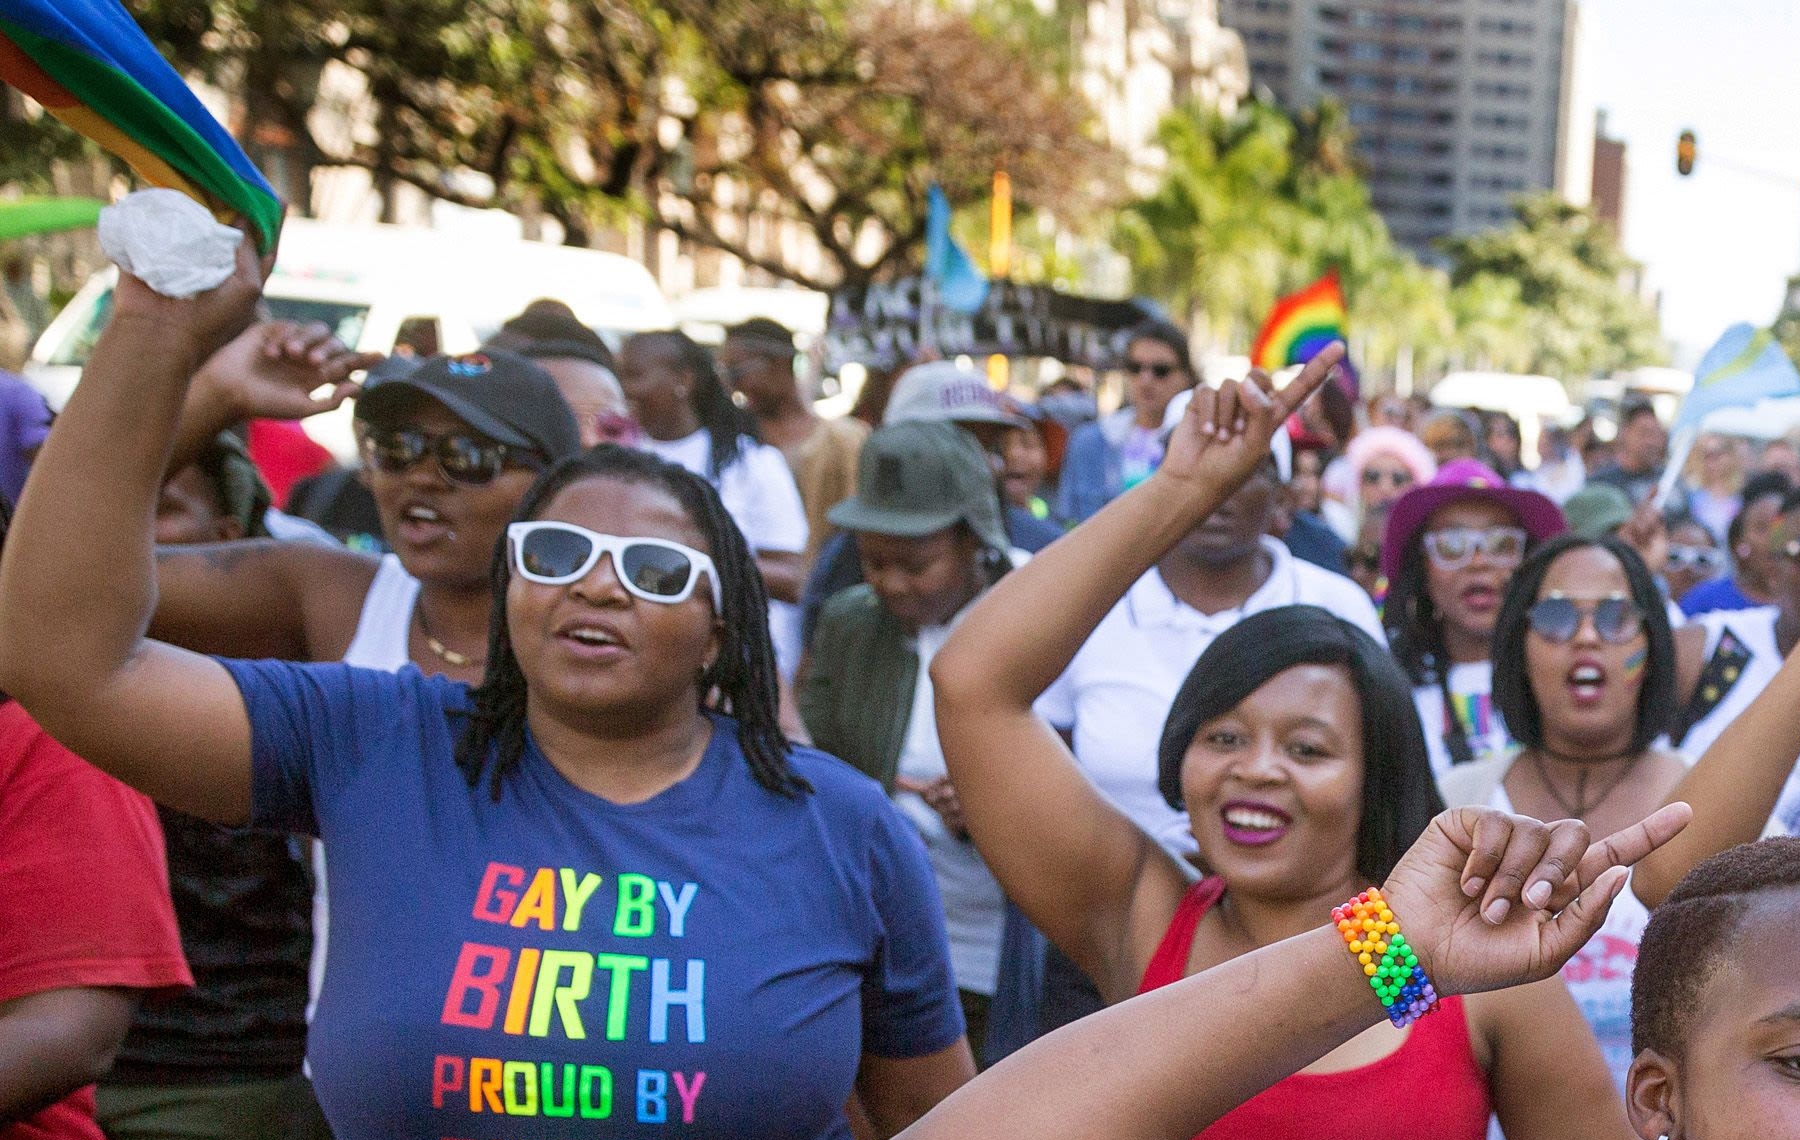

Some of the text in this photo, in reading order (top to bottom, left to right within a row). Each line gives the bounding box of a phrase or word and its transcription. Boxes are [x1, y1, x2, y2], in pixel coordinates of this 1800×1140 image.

[471, 861, 699, 938] GAY BY
[440, 941, 706, 1043] BIRTH
[432, 1055, 706, 1126] PROUD BY
